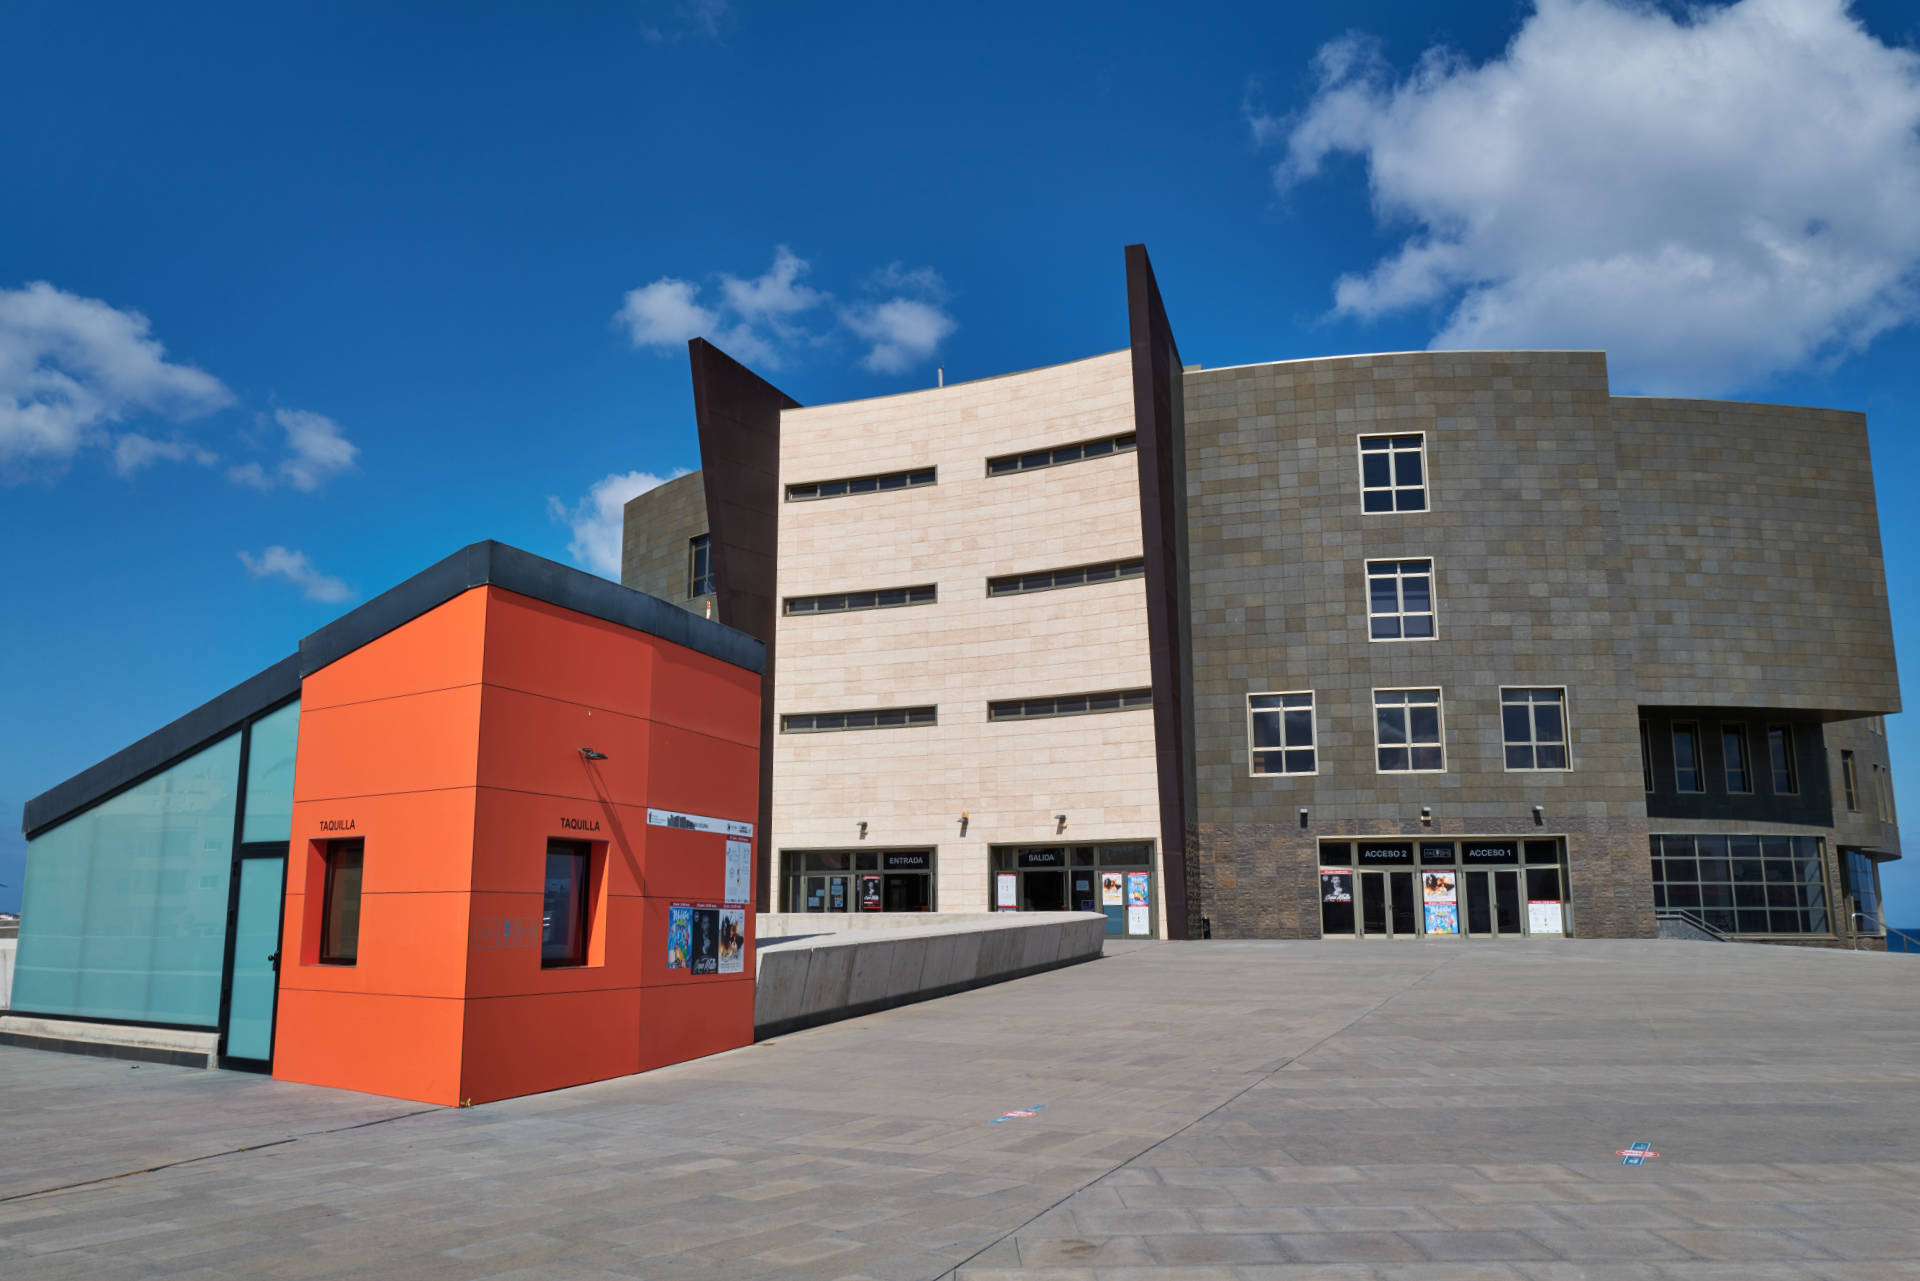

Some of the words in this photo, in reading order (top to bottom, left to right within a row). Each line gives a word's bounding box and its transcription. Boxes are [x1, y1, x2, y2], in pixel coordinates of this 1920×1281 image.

[320, 818, 356, 832] TAQUILLA
[560, 817, 601, 832] TAQUILLA
[1365, 850, 1400, 858] ACCESO
[1401, 850, 1408, 858] 2
[1469, 849, 1505, 857] ACCESO
[1506, 849, 1512, 857] 1
[888, 856, 924, 865] ENTRADA
[1028, 854, 1055, 862] SALIDA
